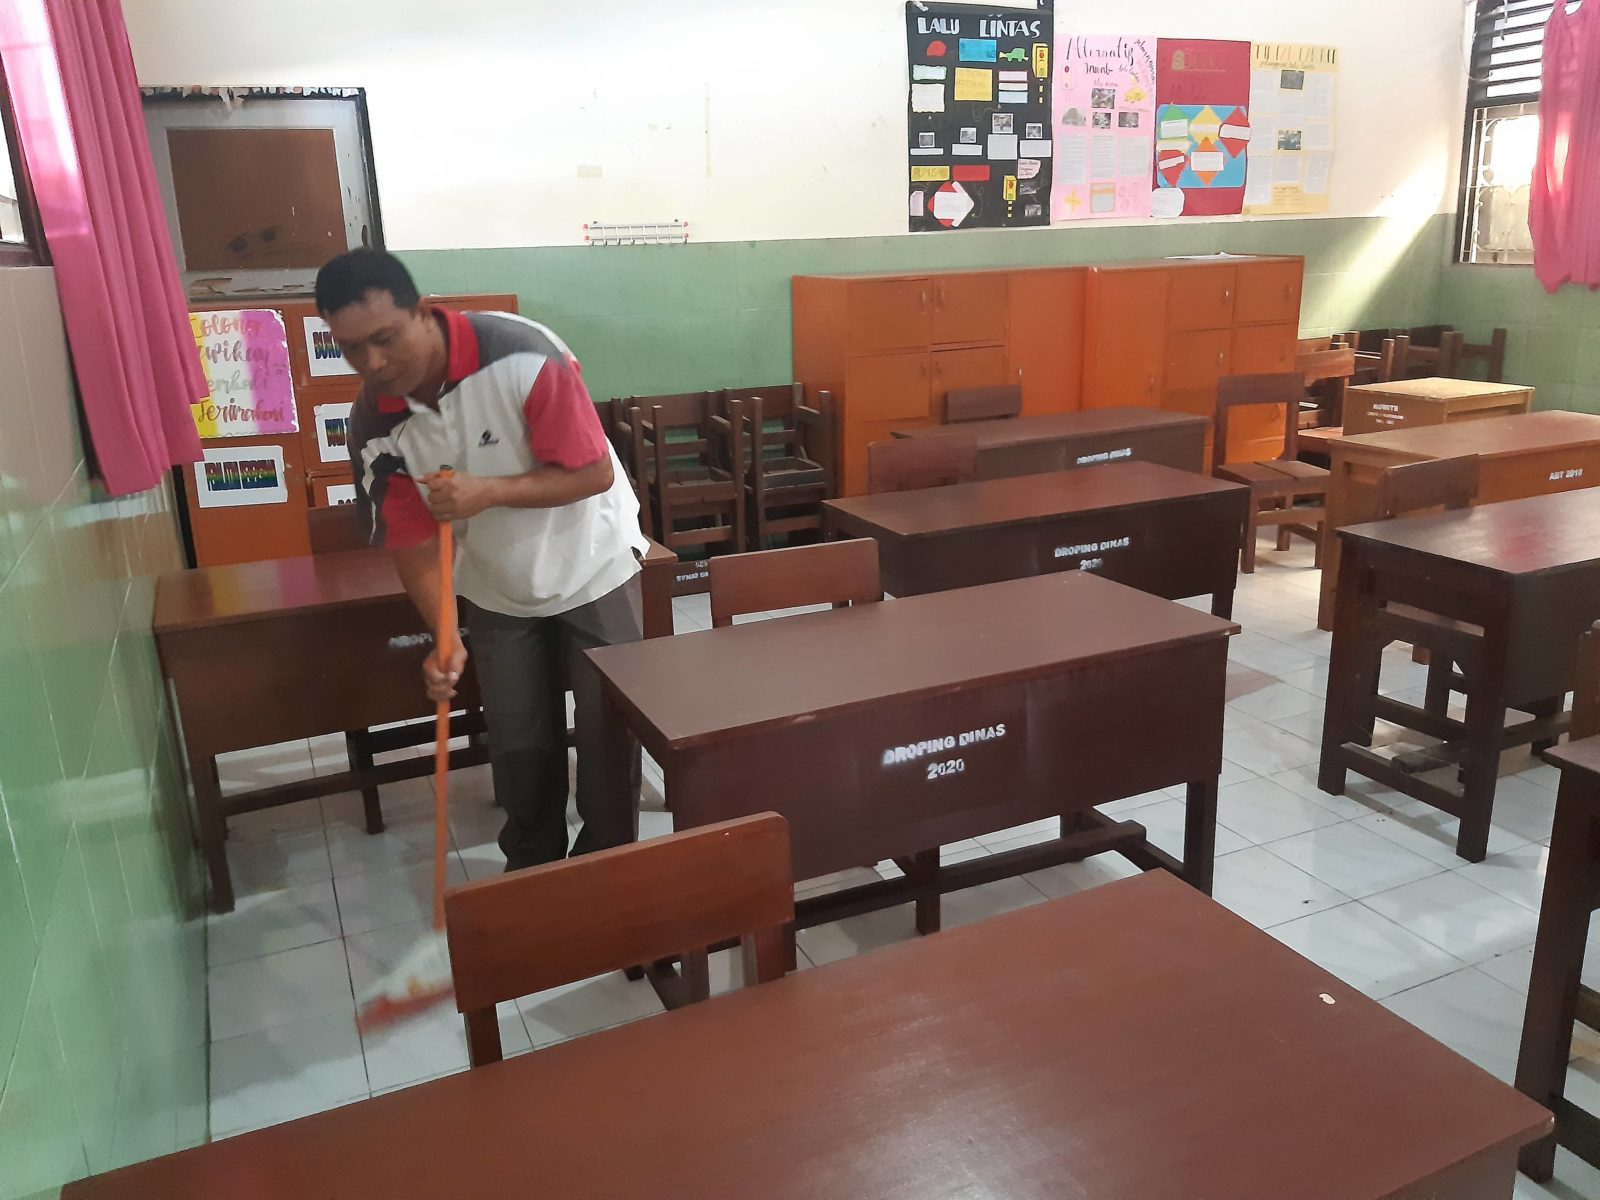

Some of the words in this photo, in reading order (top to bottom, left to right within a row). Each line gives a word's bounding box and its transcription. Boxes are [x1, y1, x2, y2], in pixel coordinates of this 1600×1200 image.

[917, 17, 960, 35] LALU
[979, 18, 1041, 38] LINTAS
[1055, 542, 1098, 558] DROPING
[1100, 537, 1130, 550] DINAS
[882, 735, 956, 765] DROPING
[959, 723, 1006, 746] DINAS
[927, 758, 965, 780] 2020
